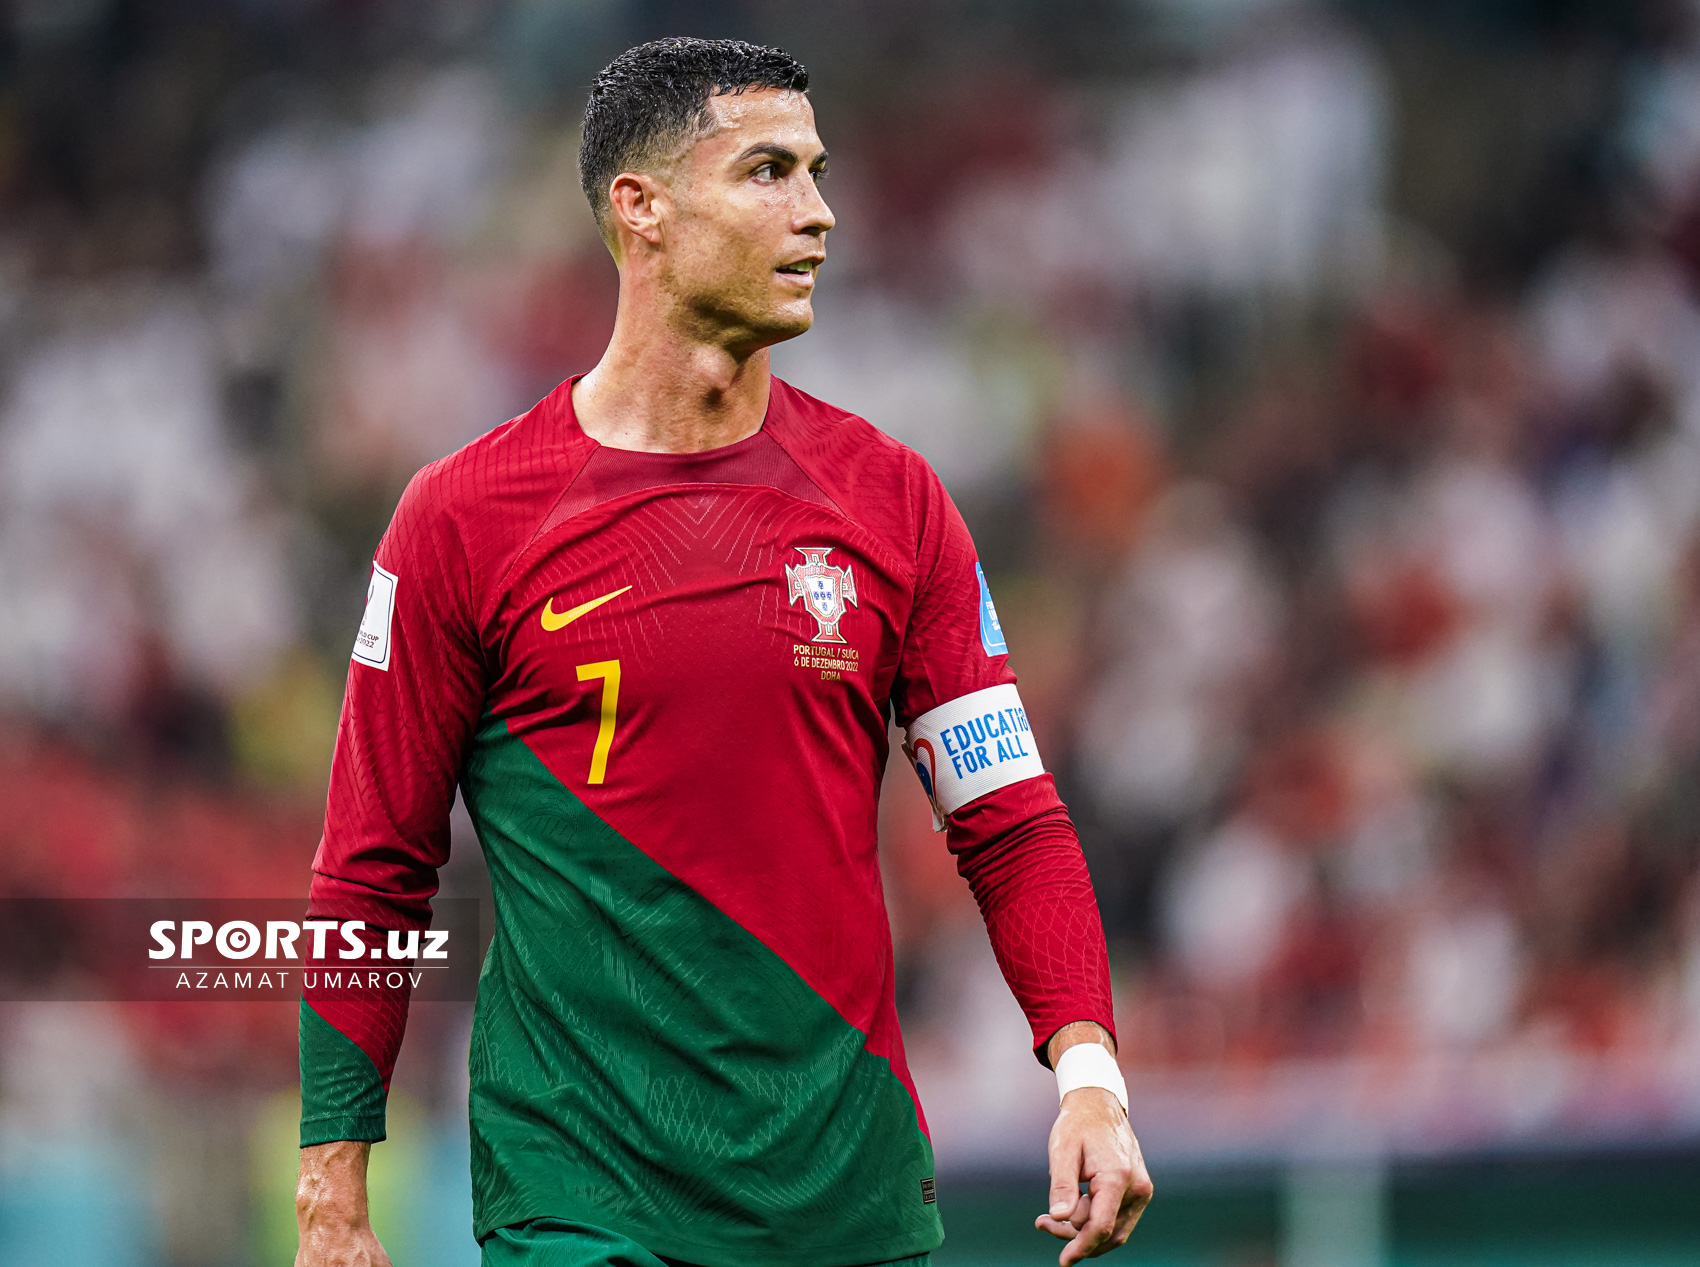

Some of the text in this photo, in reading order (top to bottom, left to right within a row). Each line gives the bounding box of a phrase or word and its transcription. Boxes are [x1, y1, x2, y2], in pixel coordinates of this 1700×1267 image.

[793, 645, 835, 657] PORTUGAL
[794, 656, 859, 672] 6 DE DEZEMBRO 2022
[821, 671, 840, 680] DOHA
[576, 660, 621, 784] 7
[939, 707, 1030, 756] EDUCATIO
[952, 735, 1029, 779] FOR ALL
